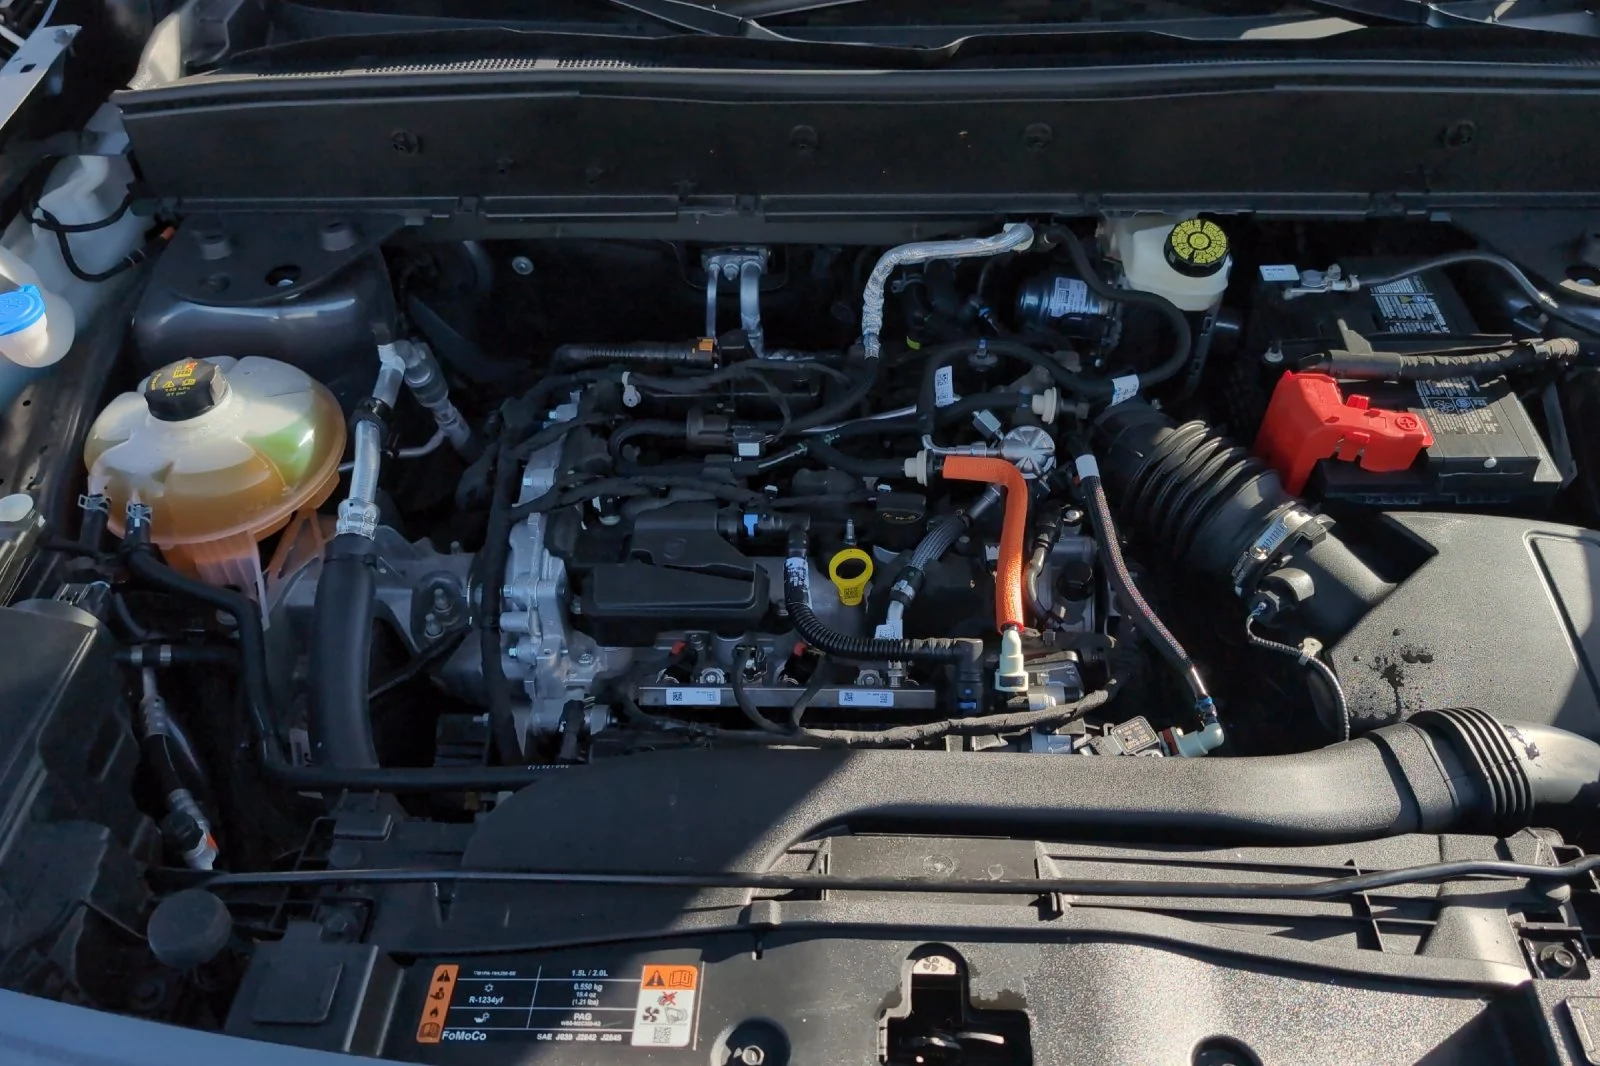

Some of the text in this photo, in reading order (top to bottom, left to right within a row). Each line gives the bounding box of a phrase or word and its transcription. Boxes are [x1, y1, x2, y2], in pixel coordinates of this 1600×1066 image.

[571, 969, 586, 977] 1.5L
[592, 969, 609, 977] 2.0L
[573, 982, 603, 993] 0.550 kg
[468, 996, 504, 1005] R-1234yf
[573, 1012, 592, 1021] PAG
[441, 1031, 487, 1040] FoMoCo
[536, 1033, 552, 1041] SAE
